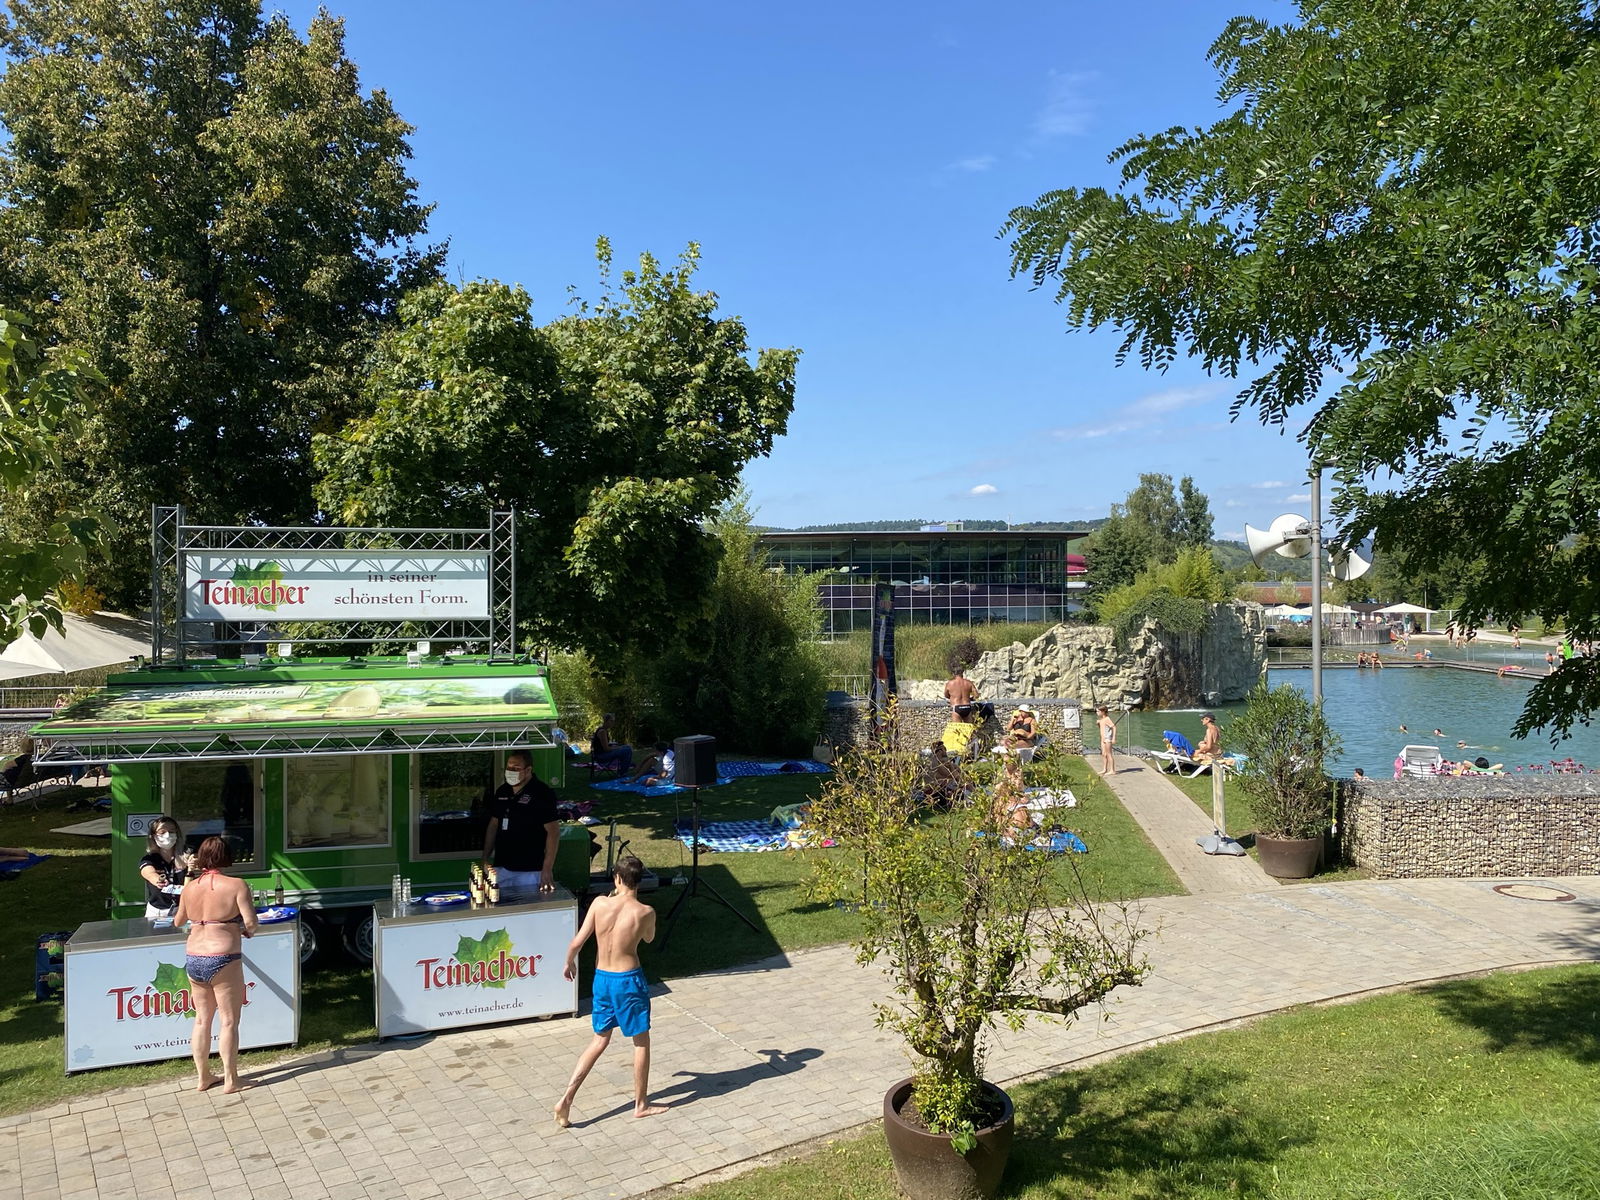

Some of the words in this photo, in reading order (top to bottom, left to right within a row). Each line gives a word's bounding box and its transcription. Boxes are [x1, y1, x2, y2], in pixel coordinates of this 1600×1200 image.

[367, 569, 384, 582] in
[389, 570, 437, 582] seiner
[198, 579, 310, 605] Teinacher
[334, 587, 413, 604] schönsten
[419, 589, 468, 604] Form.
[415, 950, 543, 989] Teinacher
[106, 981, 256, 1021] Teinar
[438, 997, 524, 1018] www.teinacher.de
